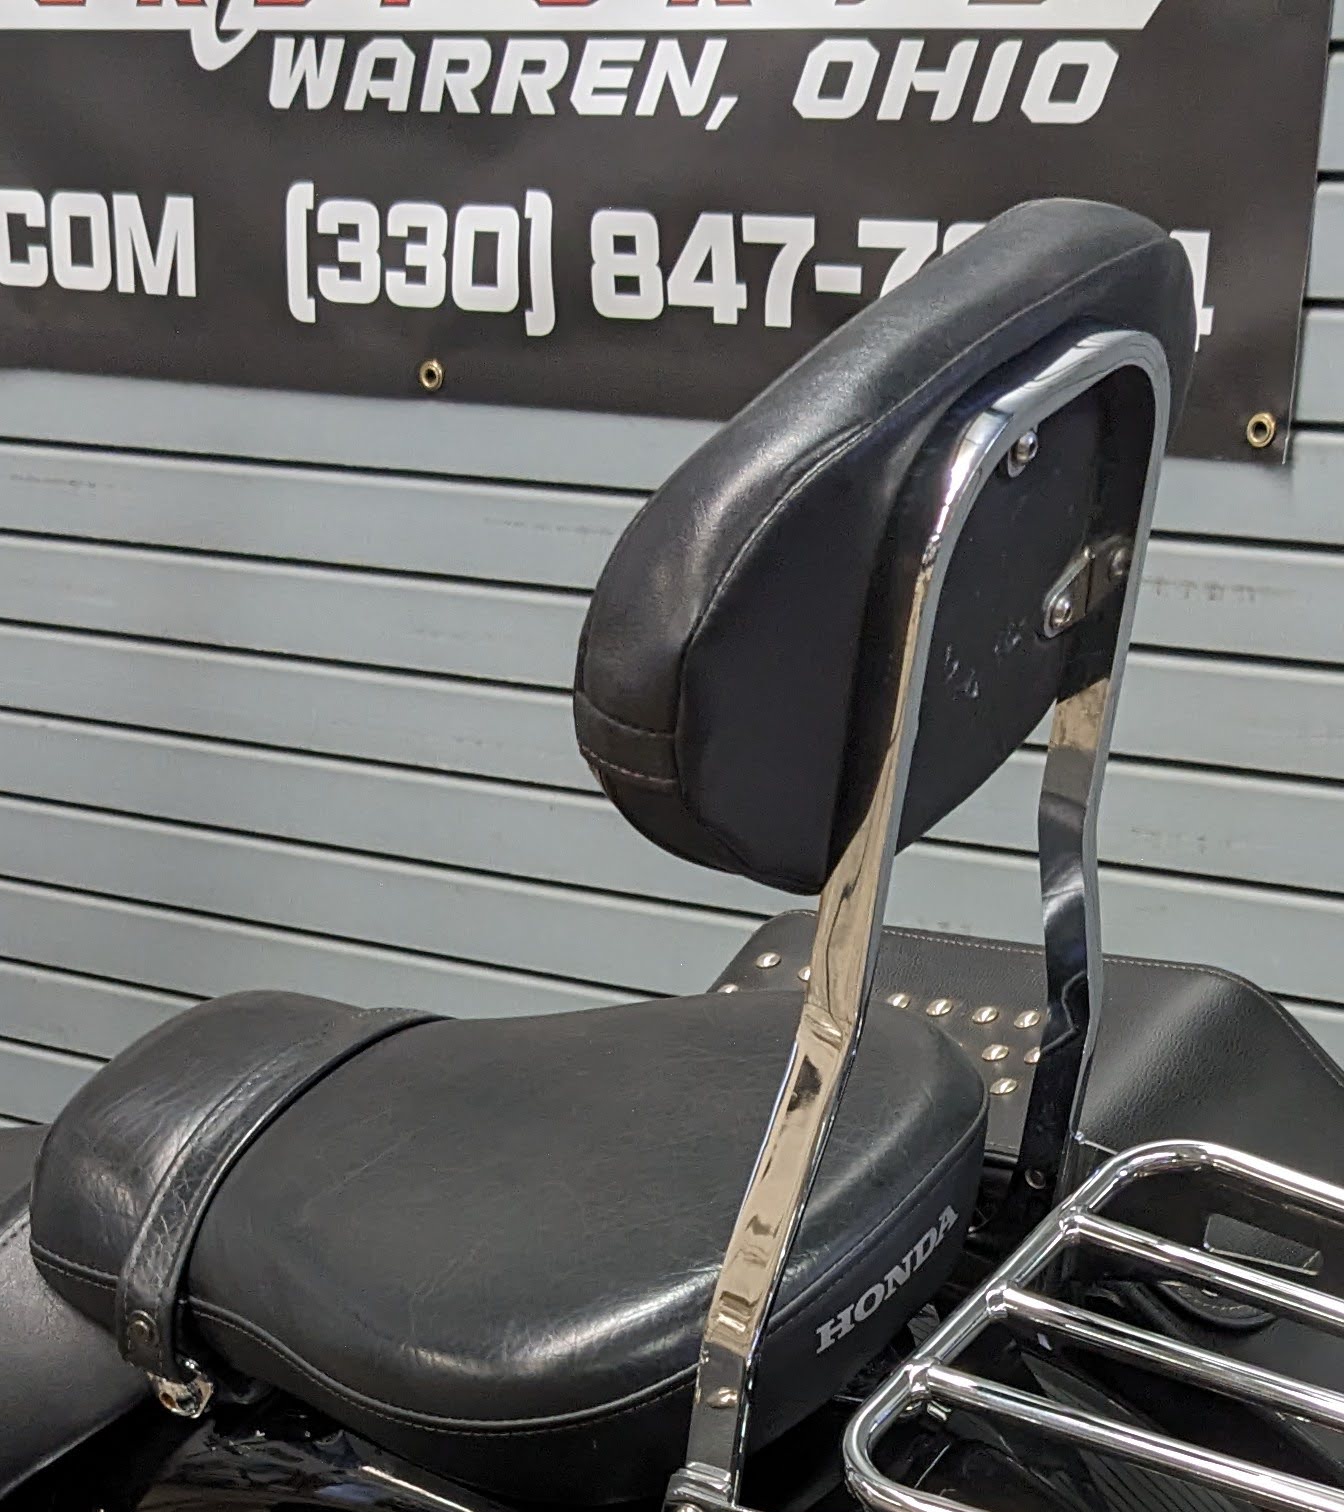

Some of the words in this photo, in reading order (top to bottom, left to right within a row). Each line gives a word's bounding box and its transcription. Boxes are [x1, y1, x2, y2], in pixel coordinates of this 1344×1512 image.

[269, 37, 738, 130] WARREN,
[792, 38, 1119, 123] OHIO
[286, 182, 556, 336] (330)
[590, 209, 1213, 352] 847-7
[815, 1205, 960, 1354] HONDA
